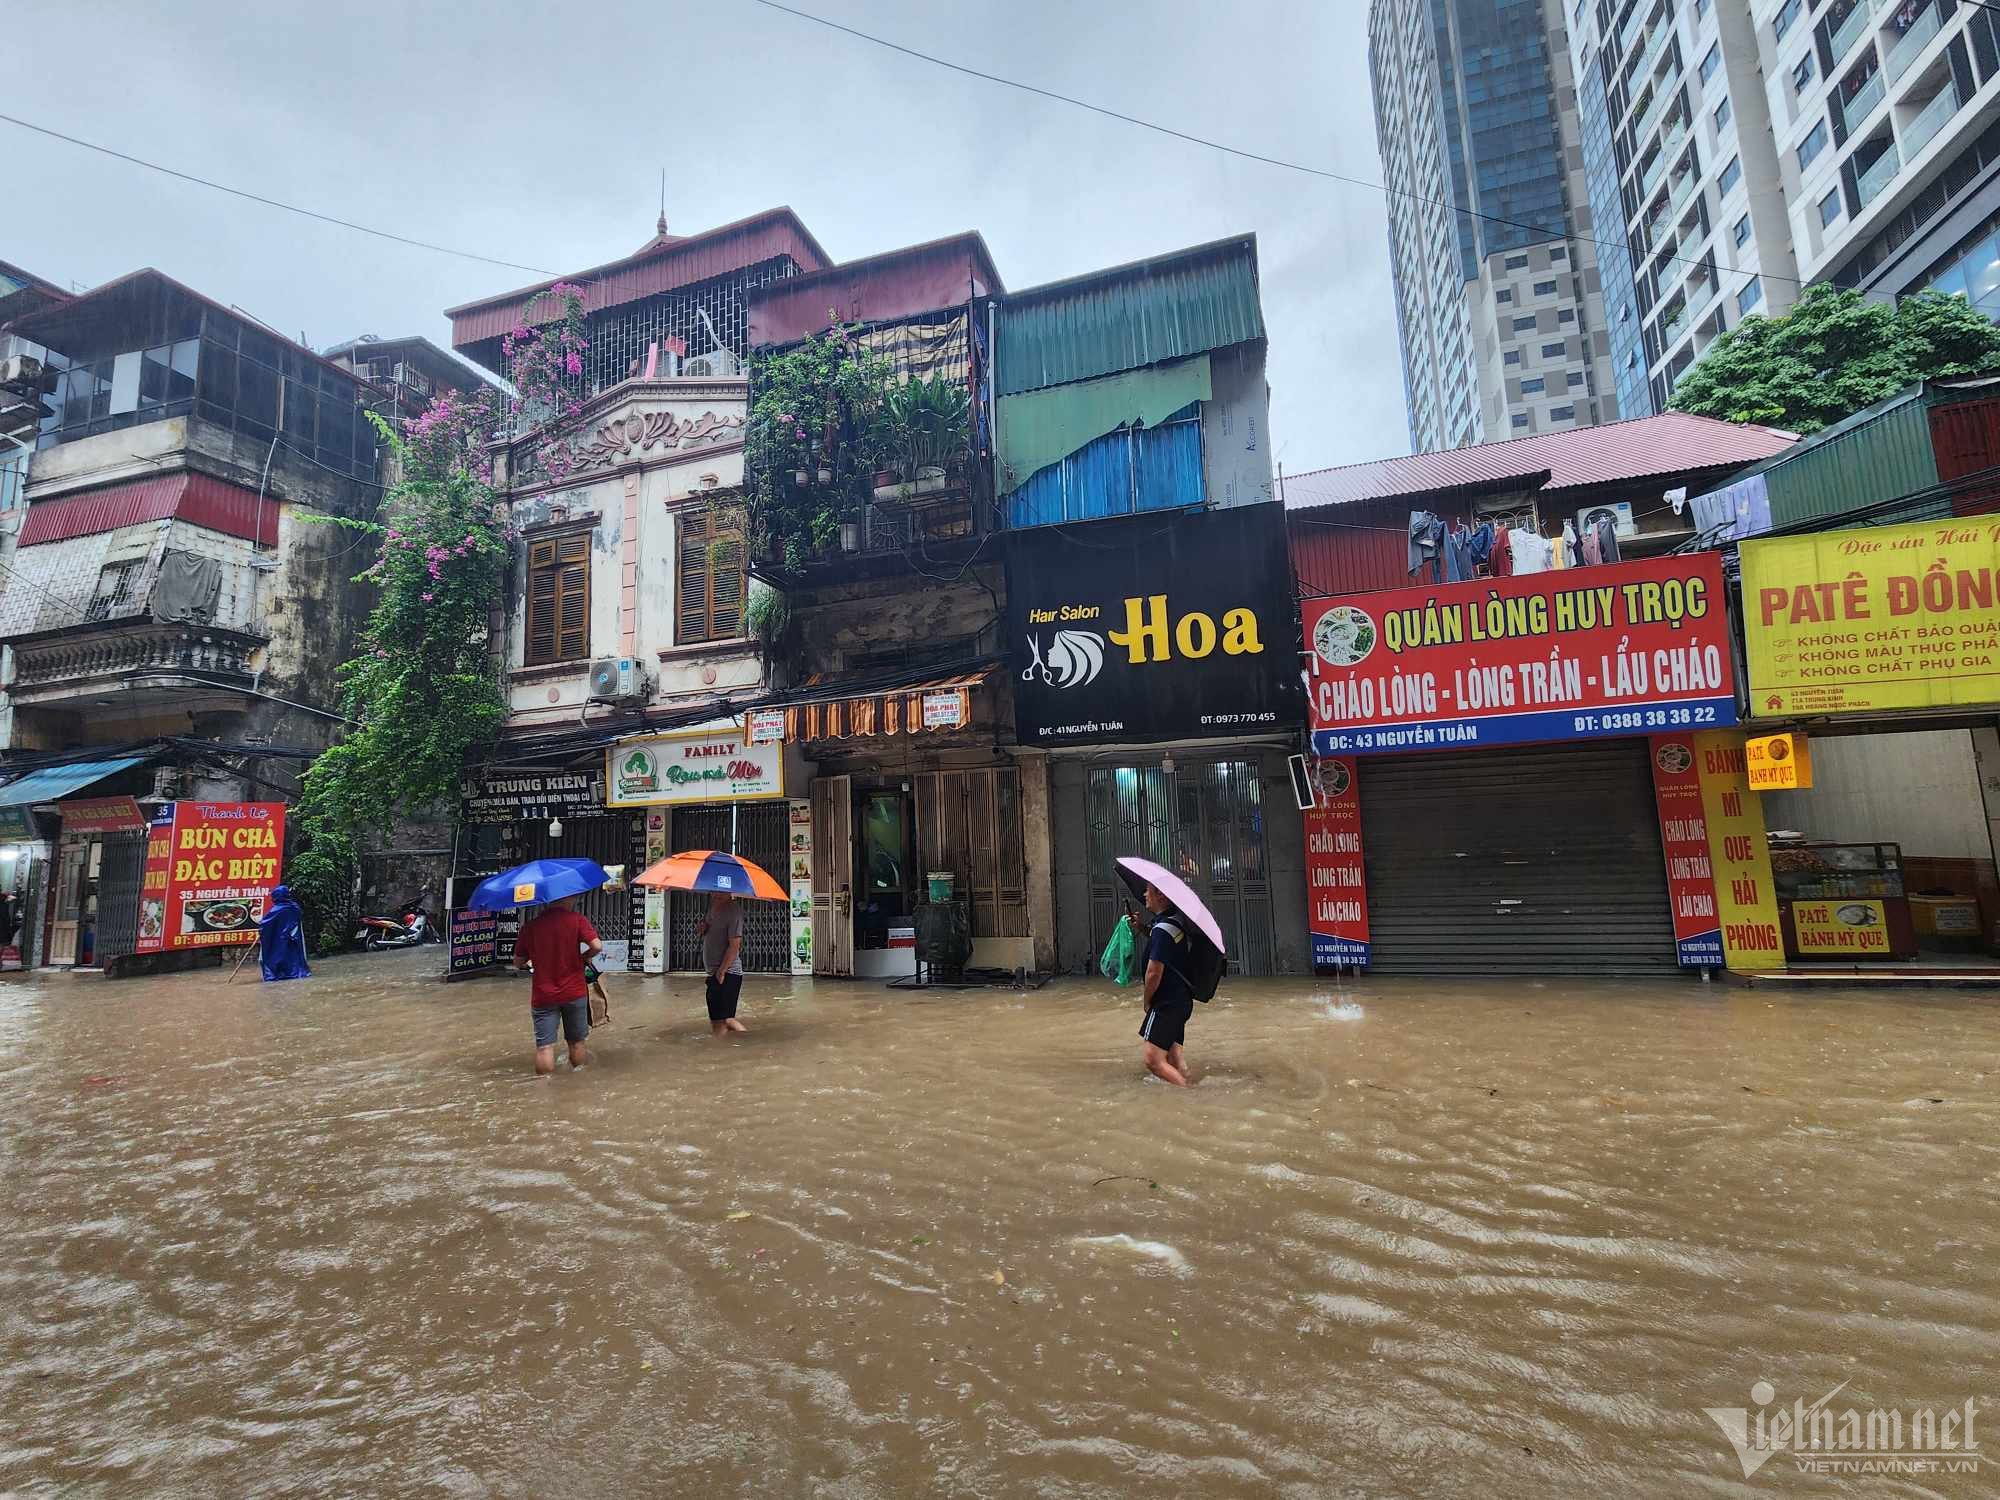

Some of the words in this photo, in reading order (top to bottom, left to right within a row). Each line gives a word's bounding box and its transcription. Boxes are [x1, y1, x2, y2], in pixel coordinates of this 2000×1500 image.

[1760, 571, 1871, 626] PATÊ
[1885, 557, 2000, 616] ĐỒN
[1060, 604, 1100, 620] Salon
[1384, 597, 1464, 653] QUÁN
[1469, 590, 1549, 641] LÒNG
[1554, 585, 1616, 632] HUY
[1621, 576, 1707, 629] TRỌC
[1107, 594, 1265, 664] Hoa
[1797, 632, 1858, 647] KHÔNG
[1864, 626, 1911, 642] CHẤT
[1917, 624, 1953, 638] BẢO
[1960, 618, 2000, 634] QUẢ
[1800, 648, 1860, 662] KHÔNG
[1866, 644, 1902, 658] MÀU
[1908, 641, 1956, 655] THỰC
[1800, 664, 1861, 678] KHÔNG
[1920, 657, 1955, 670] PHỤ
[1961, 655, 1991, 667] GIA
[1319, 671, 1375, 722] CHÁO
[1379, 665, 1437, 717] LÒNG
[1455, 658, 1515, 711] LÒNG
[1518, 645, 1582, 705] TRẦN
[1601, 635, 1648, 697] LẨU
[1653, 637, 1722, 693] CHÁO
[1100, 721, 1123, 732] TUÂN
[1240, 713, 1257, 722] 770
[1258, 712, 1276, 722] 455
[1574, 716, 1599, 732] ĐT:
[1602, 713, 1642, 730] 0388
[1646, 711, 1666, 725] 38
[1670, 708, 1691, 724] 38
[1695, 706, 1716, 722] 22
[1329, 735, 1353, 750] ĐC:
[1356, 733, 1373, 748] 43
[1376, 724, 1434, 747] NGUYỄN
[1437, 723, 1477, 742] TUÂN
[684, 743, 735, 758] FAMILY
[486, 778, 541, 793] TRUNG
[545, 774, 587, 789] KIÊN
[157, 805, 168, 816] 35
[179, 822, 229, 849] BÚN
[233, 820, 277, 849] CHẢ
[1724, 836, 1754, 864] QUE
[175, 853, 223, 887] ĐẶC
[227, 853, 277, 885] BIỆT
[179, 890, 193, 900] 35
[196, 885, 240, 899] NGUYỄN
[1731, 872, 1759, 905] HẢI
[1798, 905, 1829, 923] PATÊ
[193, 934, 221, 944] 0969
[453, 934, 473, 944] CÁC
[1725, 918, 1777, 951] PHÒNG
[1801, 927, 1835, 946] BÁNH
[1858, 931, 1884, 949] QUE
